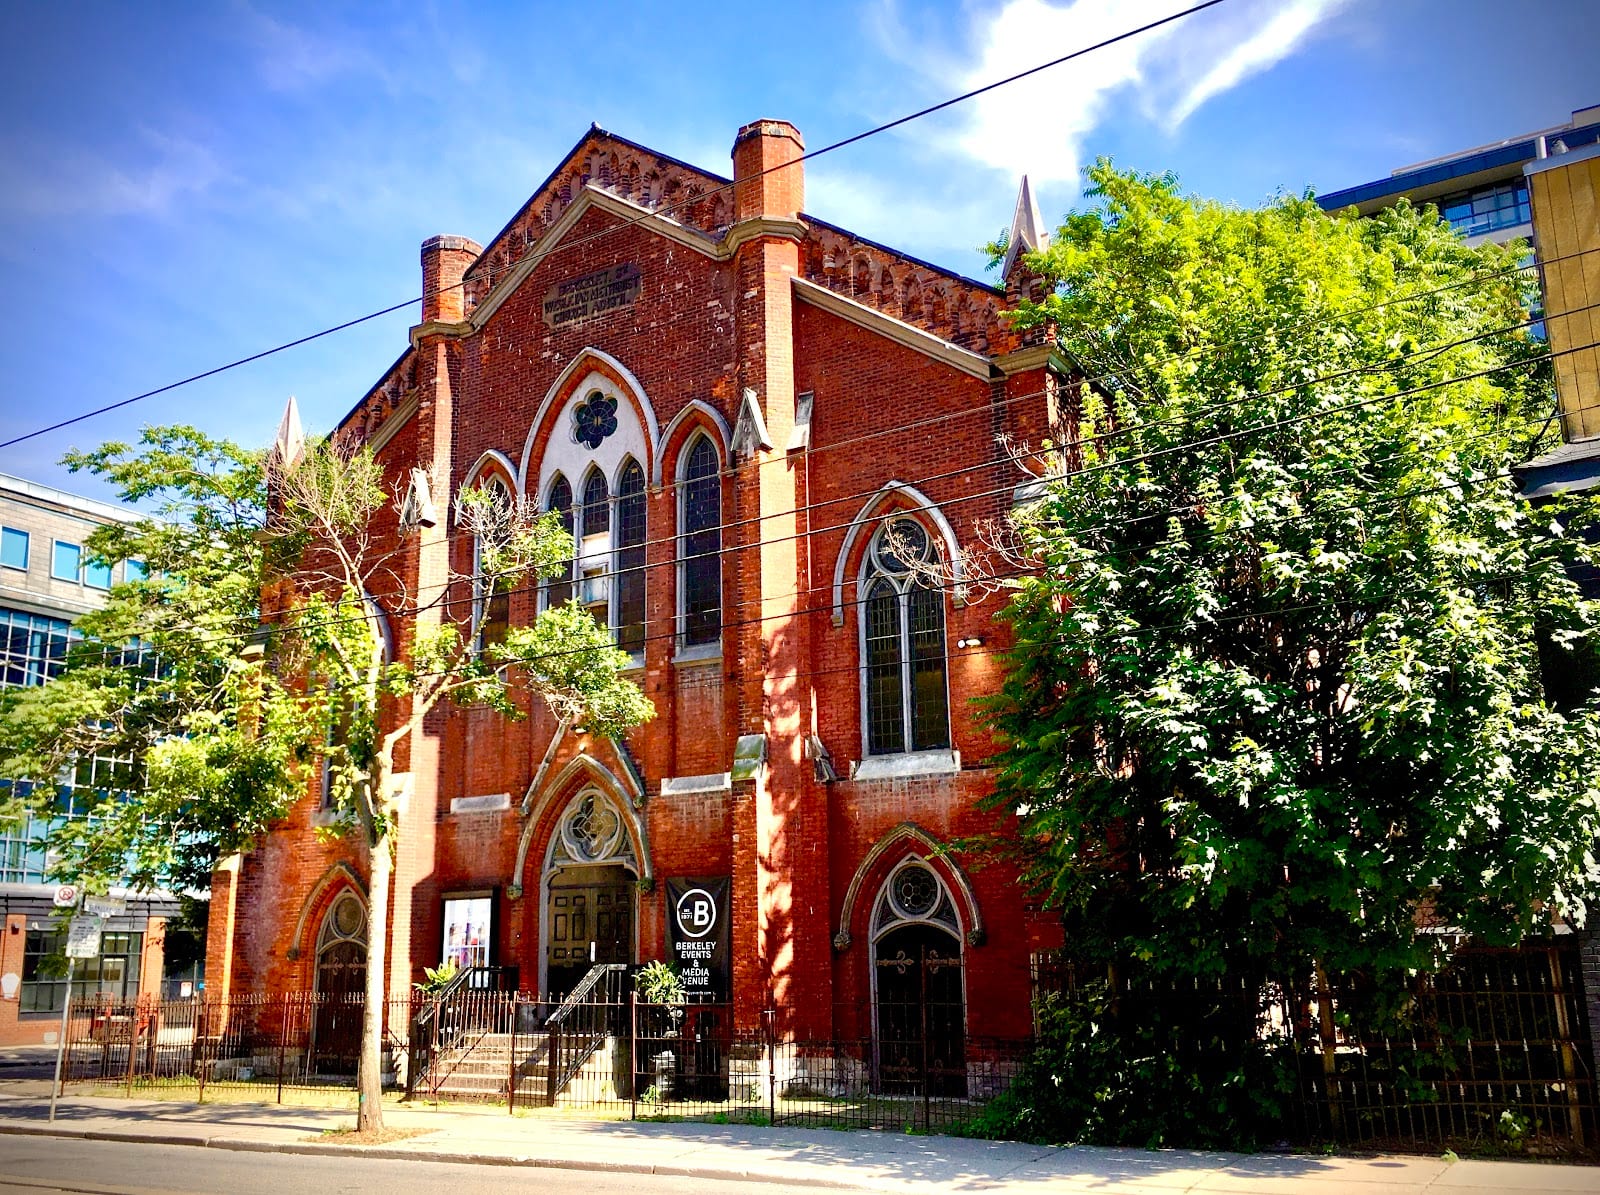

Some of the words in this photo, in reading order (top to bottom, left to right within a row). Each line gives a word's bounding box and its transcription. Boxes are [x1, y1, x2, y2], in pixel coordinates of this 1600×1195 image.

[693, 900, 710, 926] B
[675, 941, 717, 950] BERKELEY
[680, 950, 712, 959] EVENTS
[692, 959, 700, 968] &
[681, 967, 710, 977] MEDIA
[682, 976, 709, 986] VENUE
